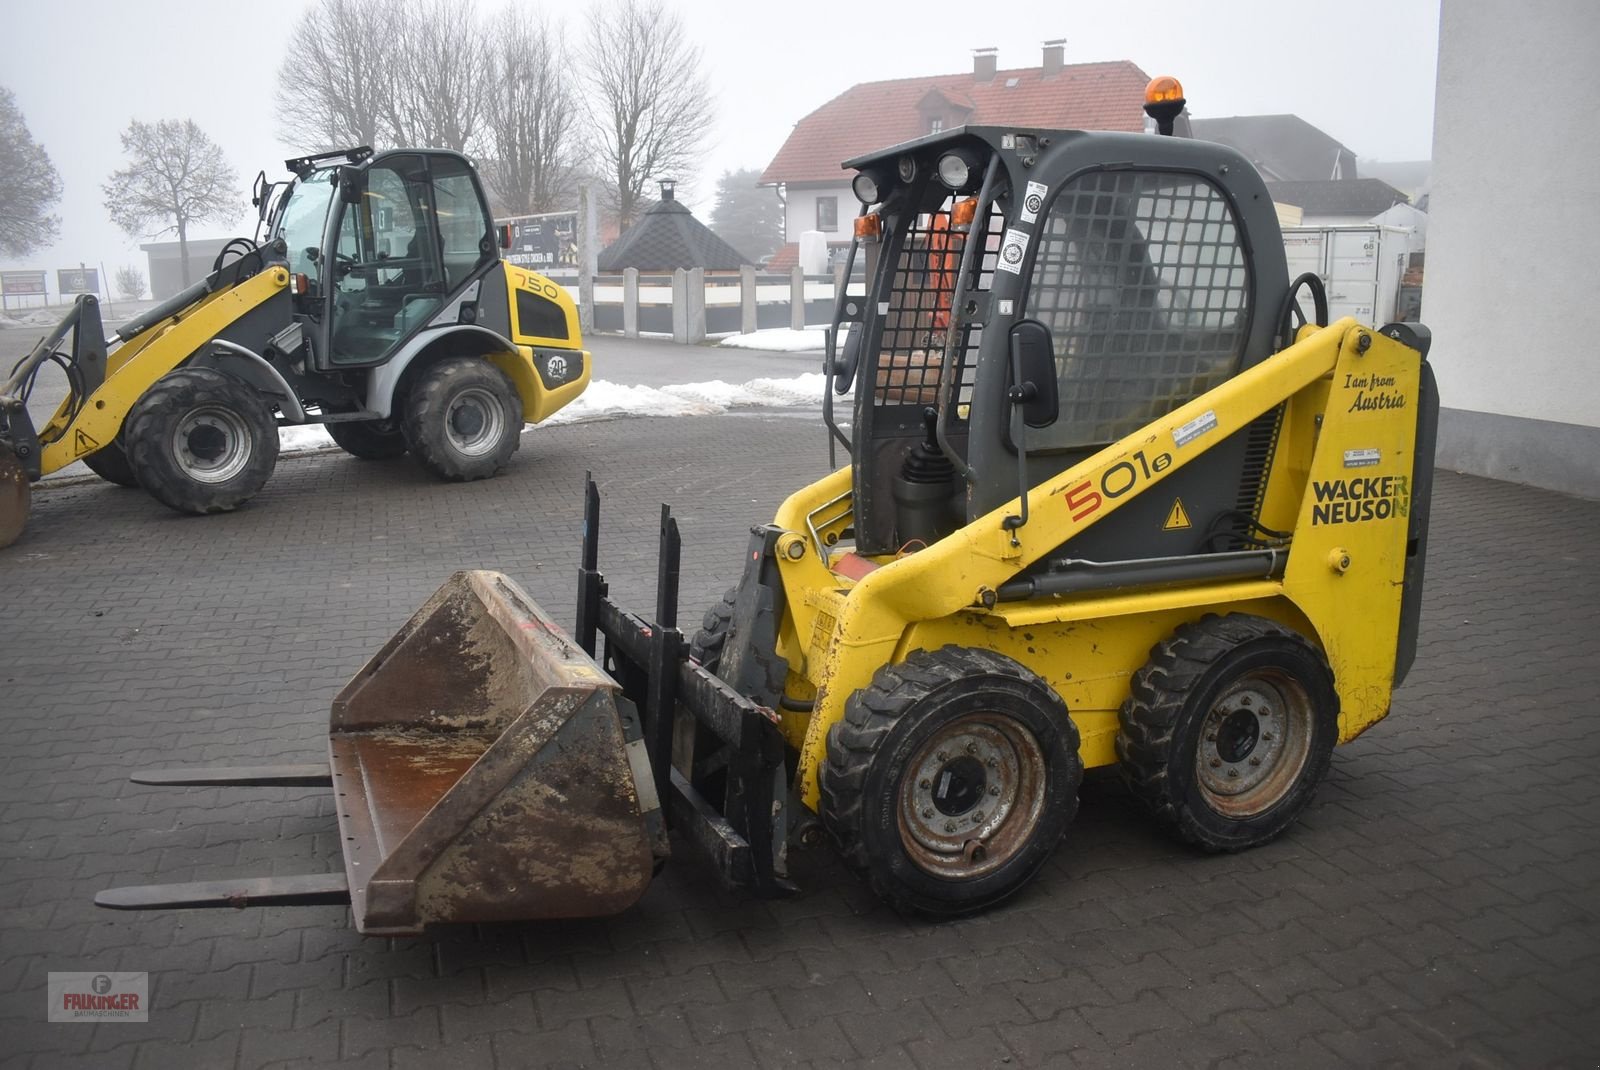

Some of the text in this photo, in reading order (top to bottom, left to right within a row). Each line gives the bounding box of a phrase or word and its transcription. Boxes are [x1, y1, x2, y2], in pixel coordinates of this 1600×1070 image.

[514, 272, 558, 299] 750
[551, 359, 563, 373] 20
[1344, 373, 1396, 391] I am from
[1348, 391, 1407, 413] Austria
[1312, 476, 1409, 502] WACKER
[1312, 497, 1409, 526] NEUSON
